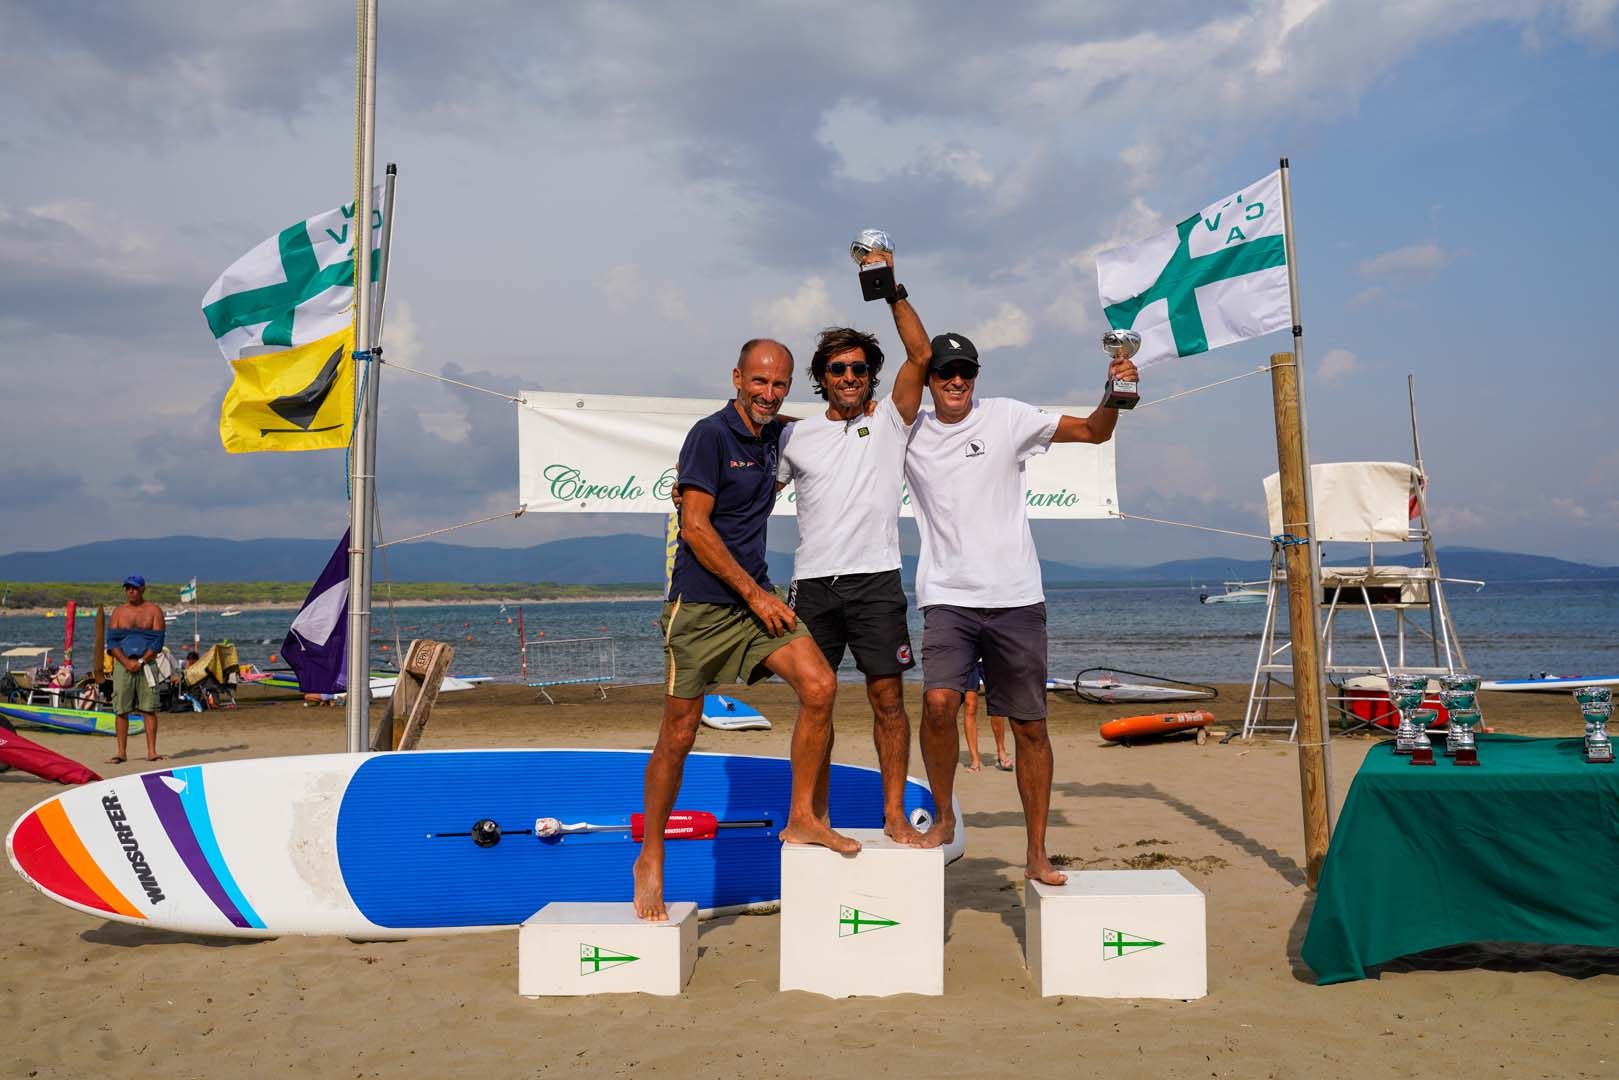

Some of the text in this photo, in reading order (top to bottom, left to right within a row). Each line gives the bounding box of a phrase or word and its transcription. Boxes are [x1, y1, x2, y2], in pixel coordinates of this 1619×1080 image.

[543, 464, 645, 501] Circolo
[1025, 488, 1080, 507] tario
[101, 795, 166, 906] WINDSURFER
